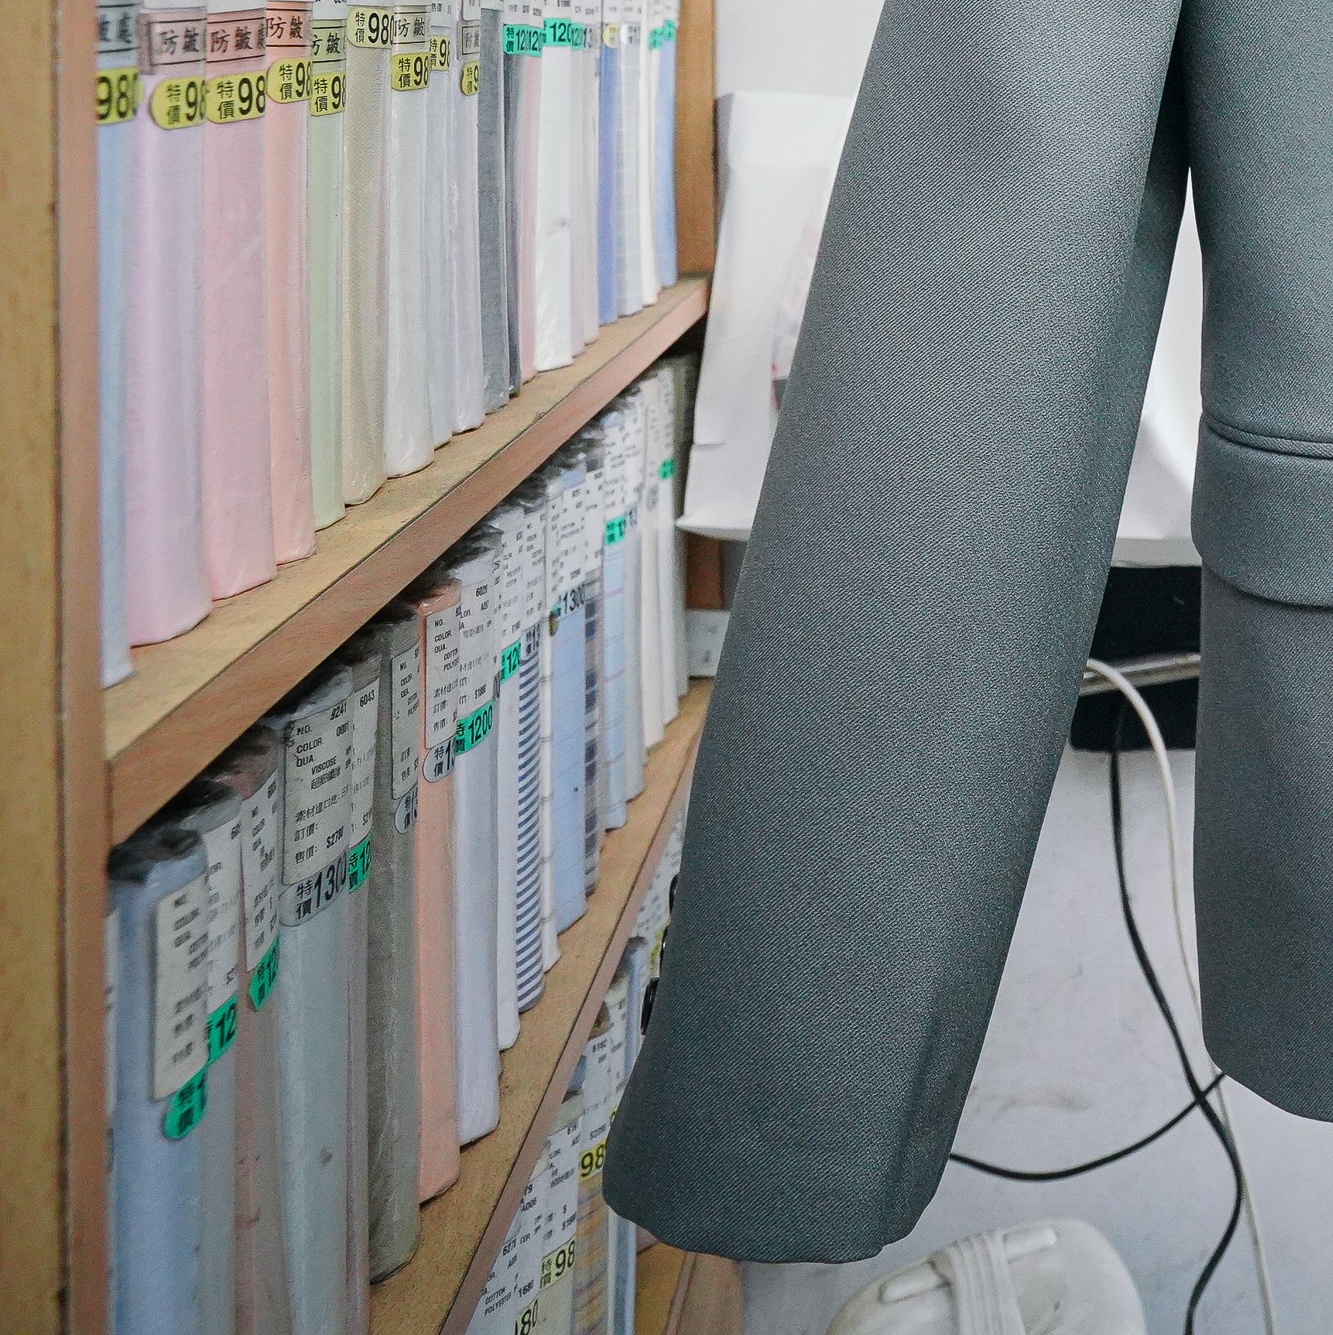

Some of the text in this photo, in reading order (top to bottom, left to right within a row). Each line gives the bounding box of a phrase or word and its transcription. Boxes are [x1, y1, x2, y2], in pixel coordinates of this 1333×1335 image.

[355, 12, 366, 43] 特價
[279, 64, 293, 100] 特價
[398, 58, 411, 88] 特價
[217, 81, 234, 120] 特價
[313, 78, 329, 112] 特價
[360, 689, 375, 707] 6043
[468, 705, 493, 744] 1200
[296, 737, 324, 754] COLOR.
[434, 745, 444, 778] 特價
[296, 879, 314, 919] 特價
